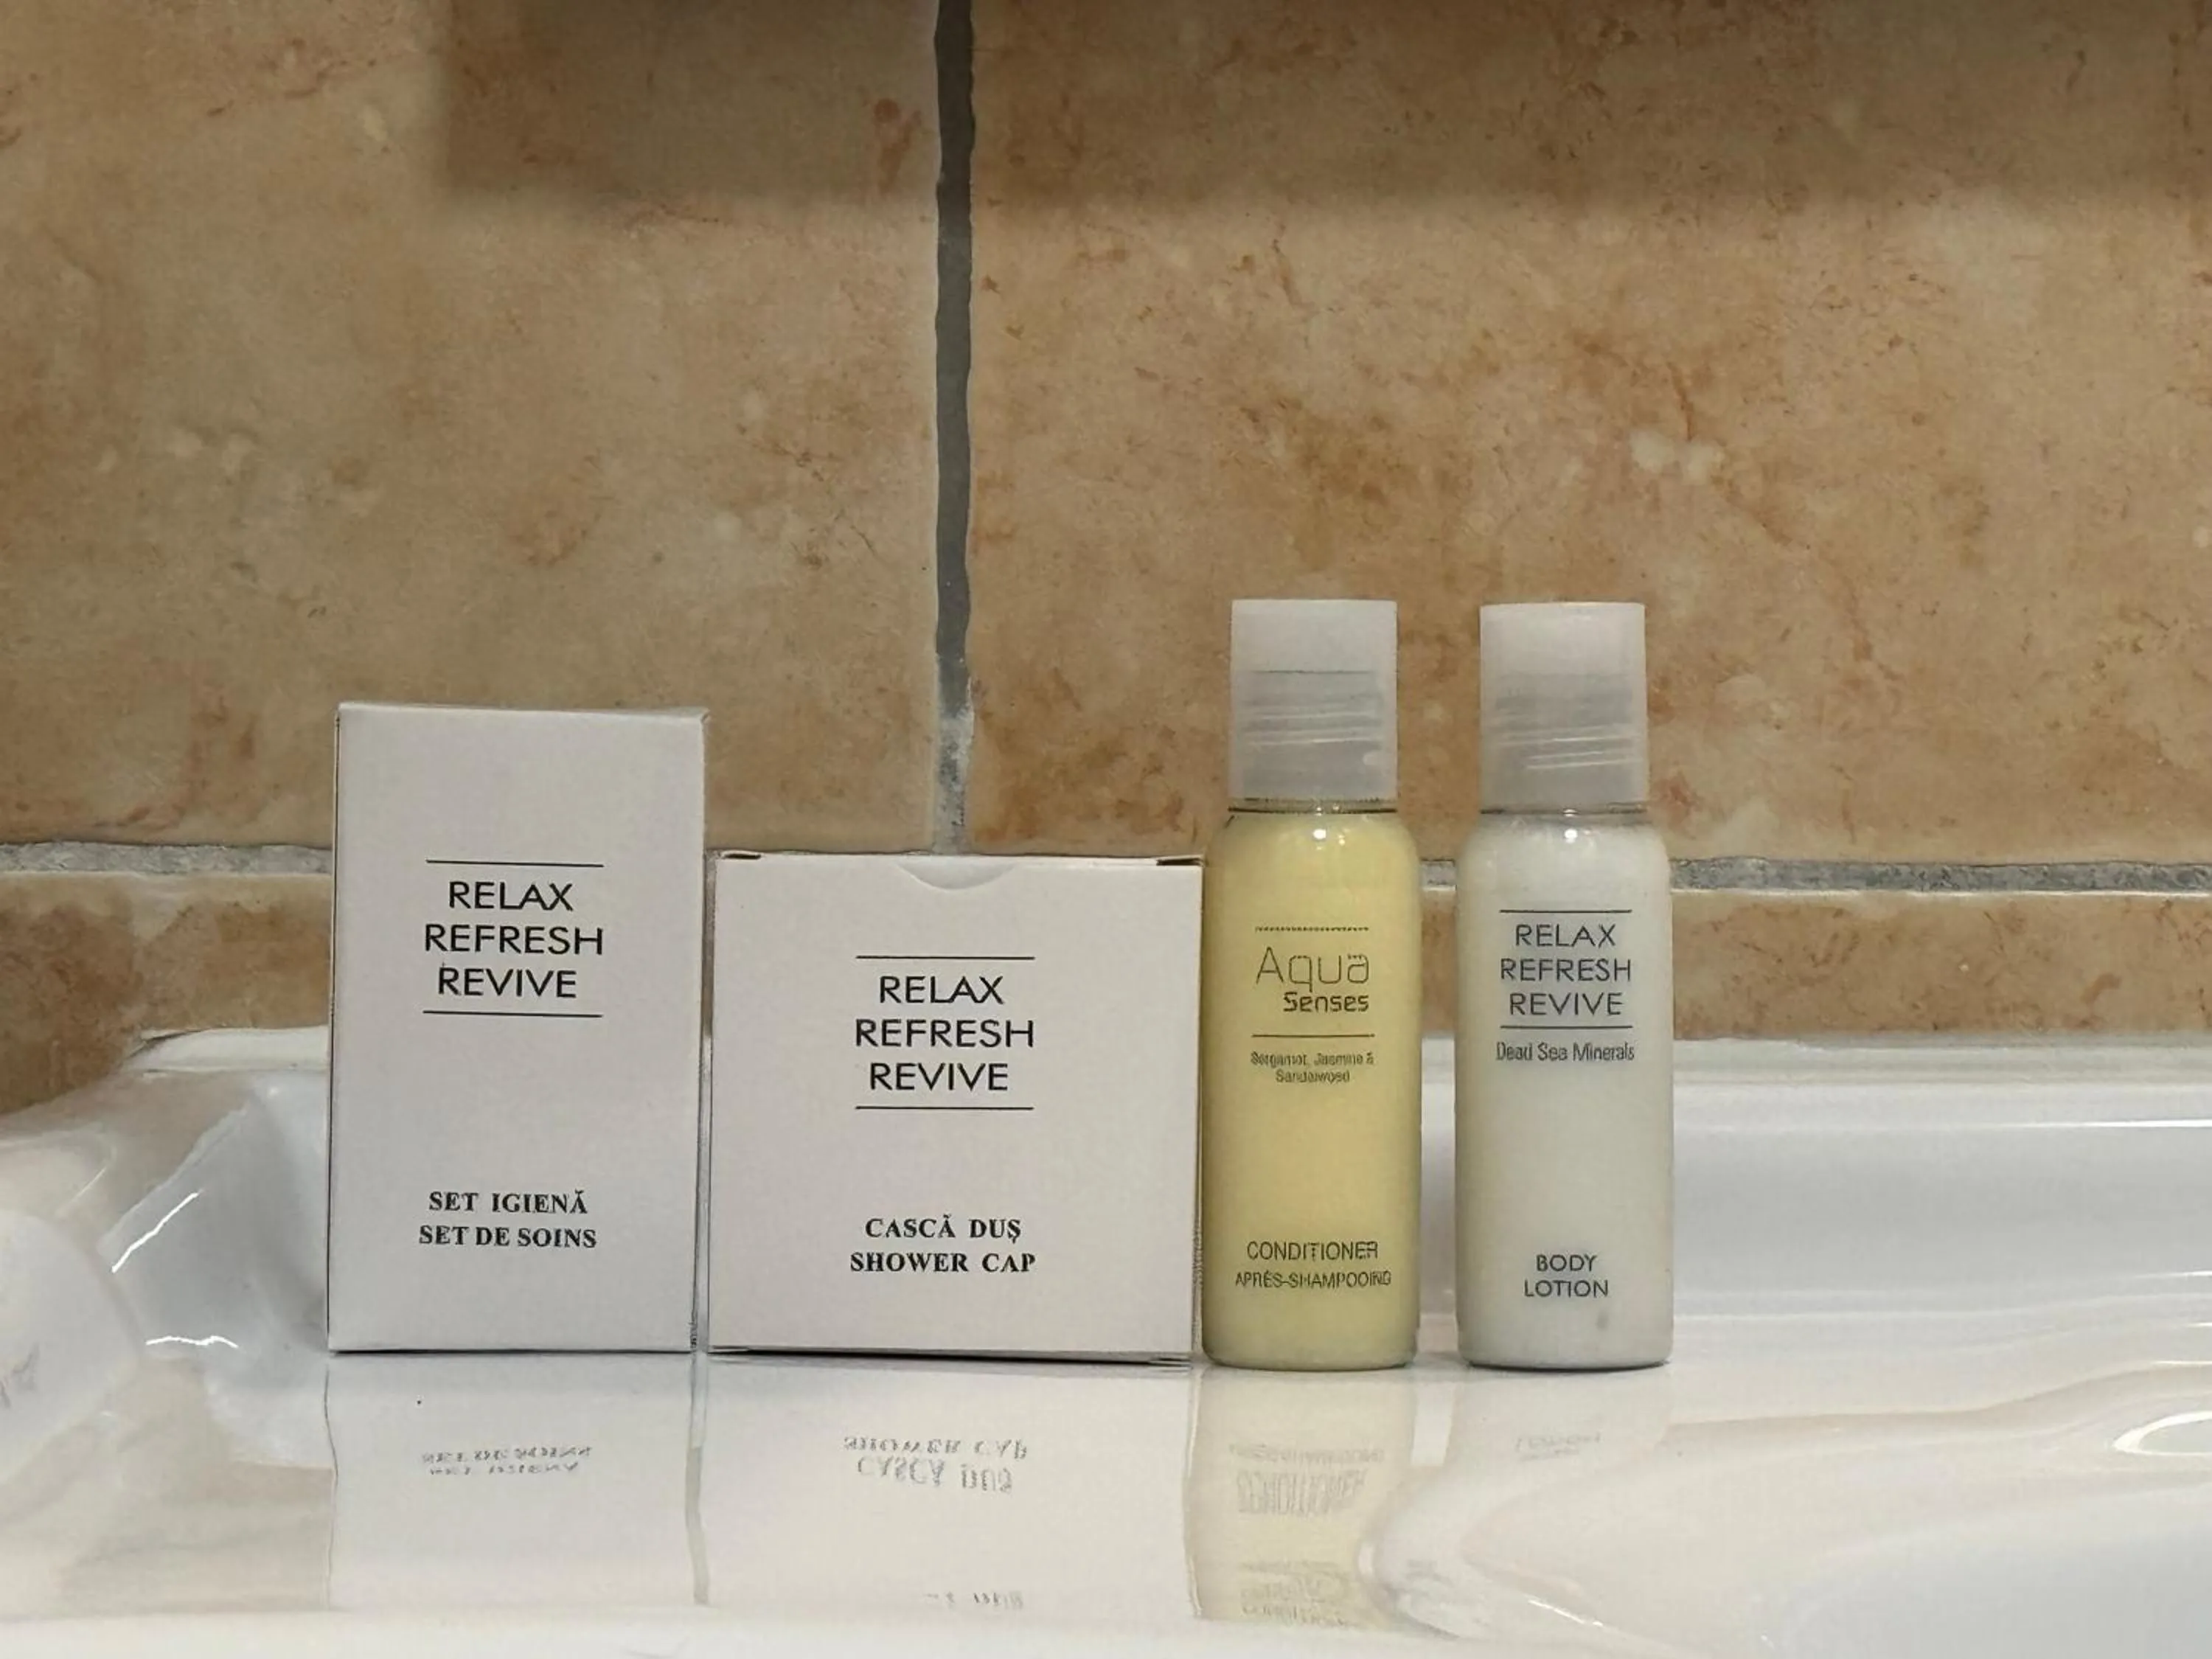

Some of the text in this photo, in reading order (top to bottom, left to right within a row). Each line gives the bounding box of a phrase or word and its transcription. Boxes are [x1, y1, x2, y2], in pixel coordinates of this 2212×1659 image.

[448, 881, 574, 911] RELAX
[425, 924, 604, 956] REFRESH
[1515, 924, 1616, 947] RELAX
[1256, 946, 1369, 992] Aqua
[1500, 958, 1632, 982] REFRESH
[437, 967, 577, 998] REVIVE
[879, 975, 1004, 1004] RELAX
[1283, 991, 1369, 1012] Senses
[1509, 992, 1624, 1016] REVIVE
[855, 1019, 1034, 1048] REFRESH
[1496, 1041, 1635, 1061] Dead Sea Minerals
[869, 1062, 1009, 1091] REVIVE
[429, 1189, 588, 1214] SET IGIENĂ
[419, 1225, 597, 1248] SET DE SOINS
[850, 1252, 1036, 1273] SHOWER CAP
[1247, 1240, 1378, 1261] CONDITIONER
[1536, 1254, 1598, 1272] BODY
[1524, 1279, 1609, 1298] LOTION
